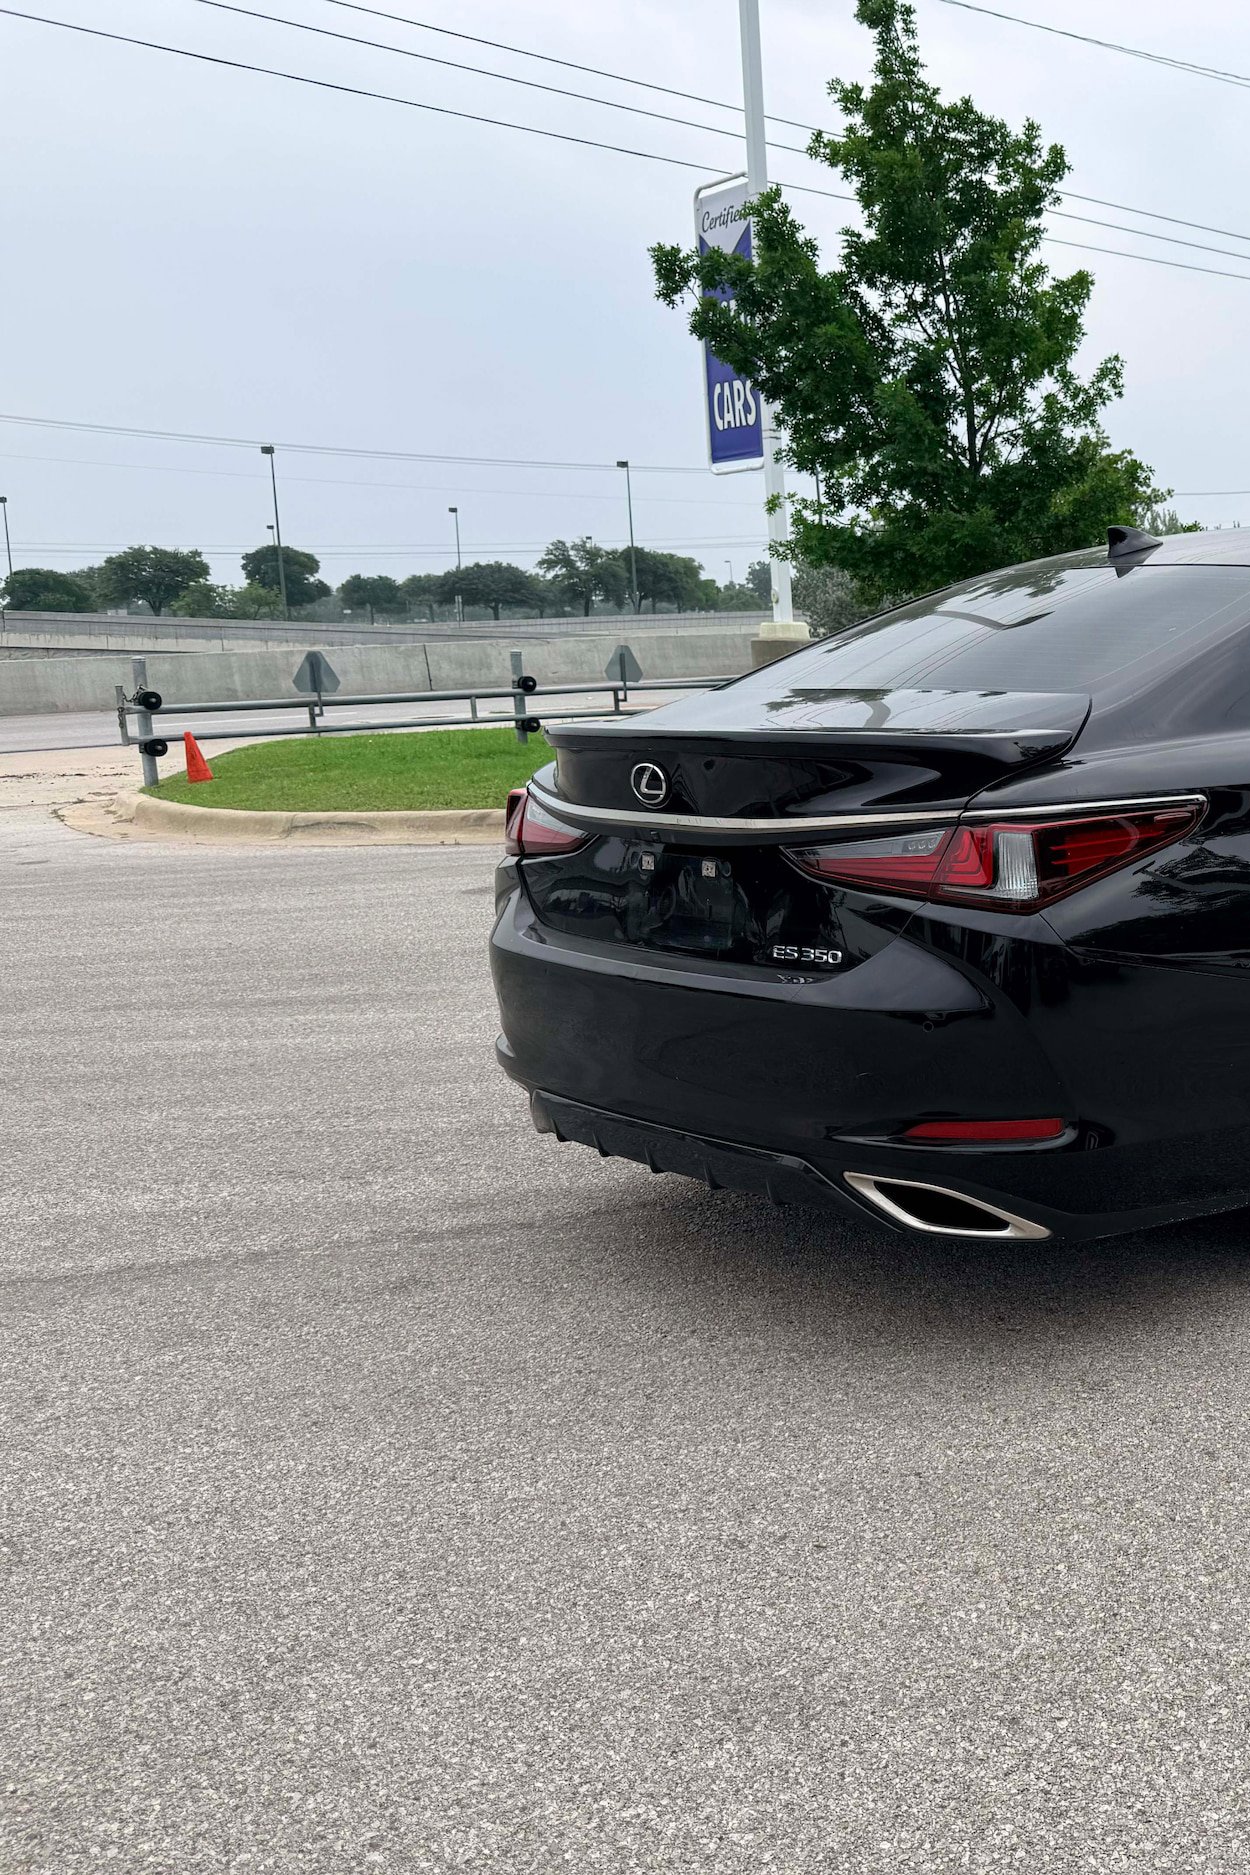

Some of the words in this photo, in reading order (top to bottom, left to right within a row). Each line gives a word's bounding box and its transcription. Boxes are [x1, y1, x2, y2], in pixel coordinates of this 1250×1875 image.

[702, 204, 748, 233] Certifie
[713, 379, 756, 431] CARS
[773, 945, 798, 959] ES
[800, 947, 842, 964] 350
